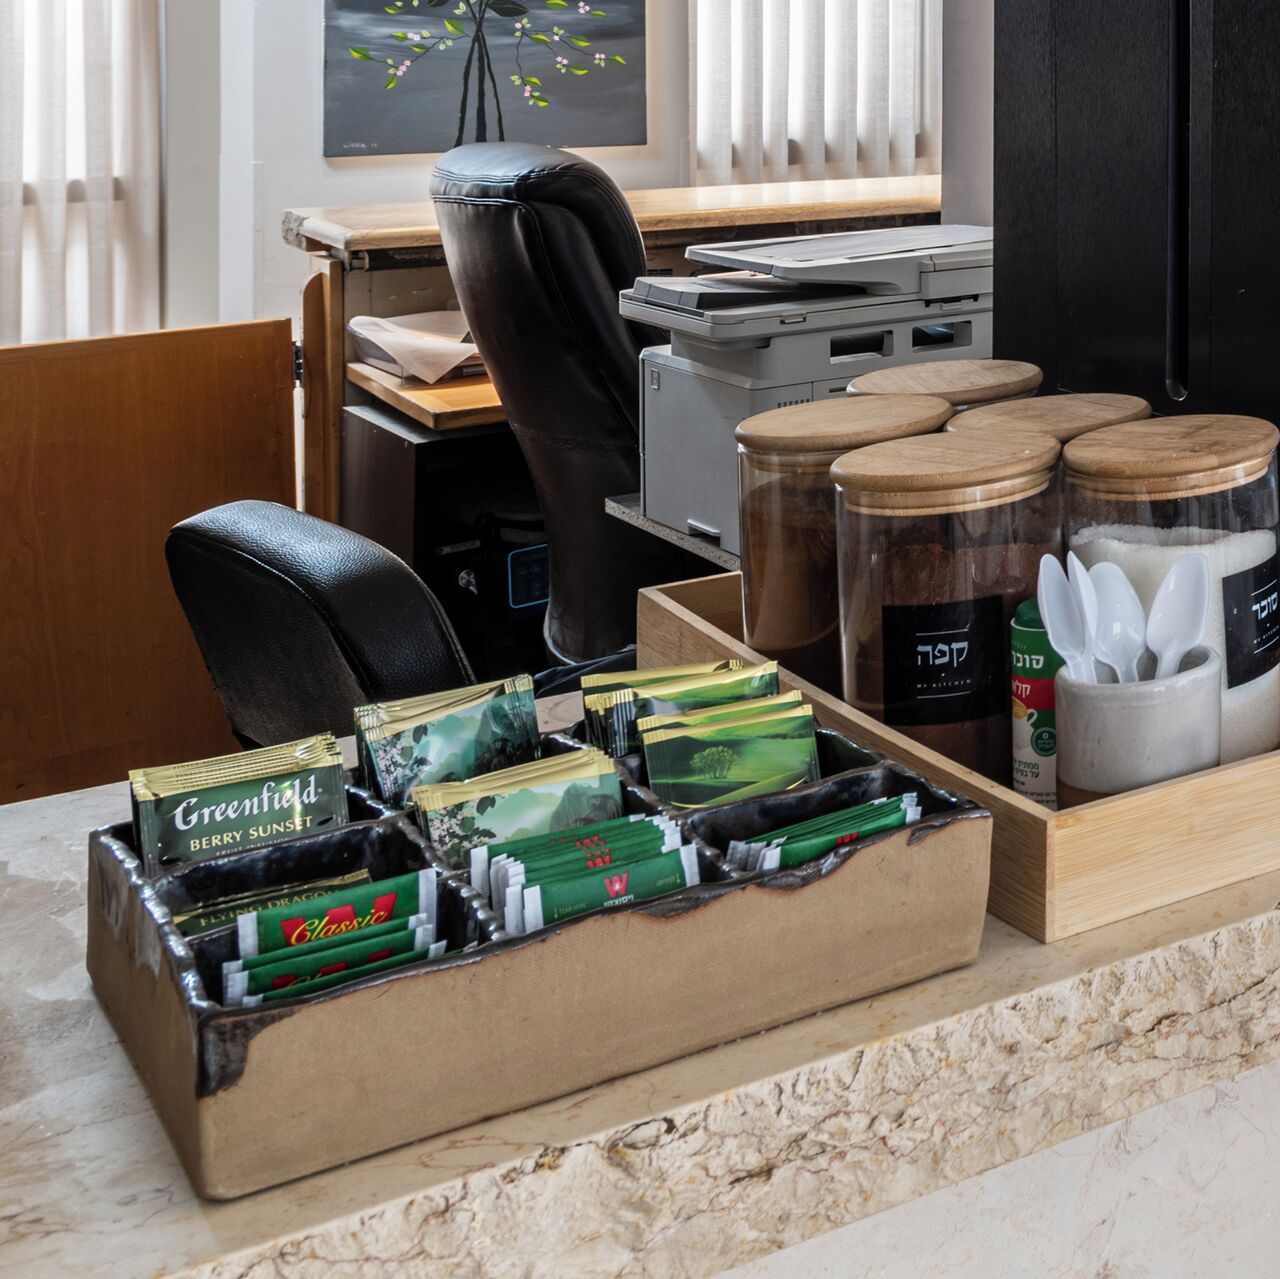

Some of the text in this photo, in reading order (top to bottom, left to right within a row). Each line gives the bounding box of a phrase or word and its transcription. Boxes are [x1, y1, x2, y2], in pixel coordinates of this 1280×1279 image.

[1251, 591, 1278, 620] סוכר
[916, 641, 969, 668] קפה
[171, 774, 319, 831] Greenfield
[190, 816, 313, 852] BERRY SUNSET
[290, 908, 389, 946] Classic
